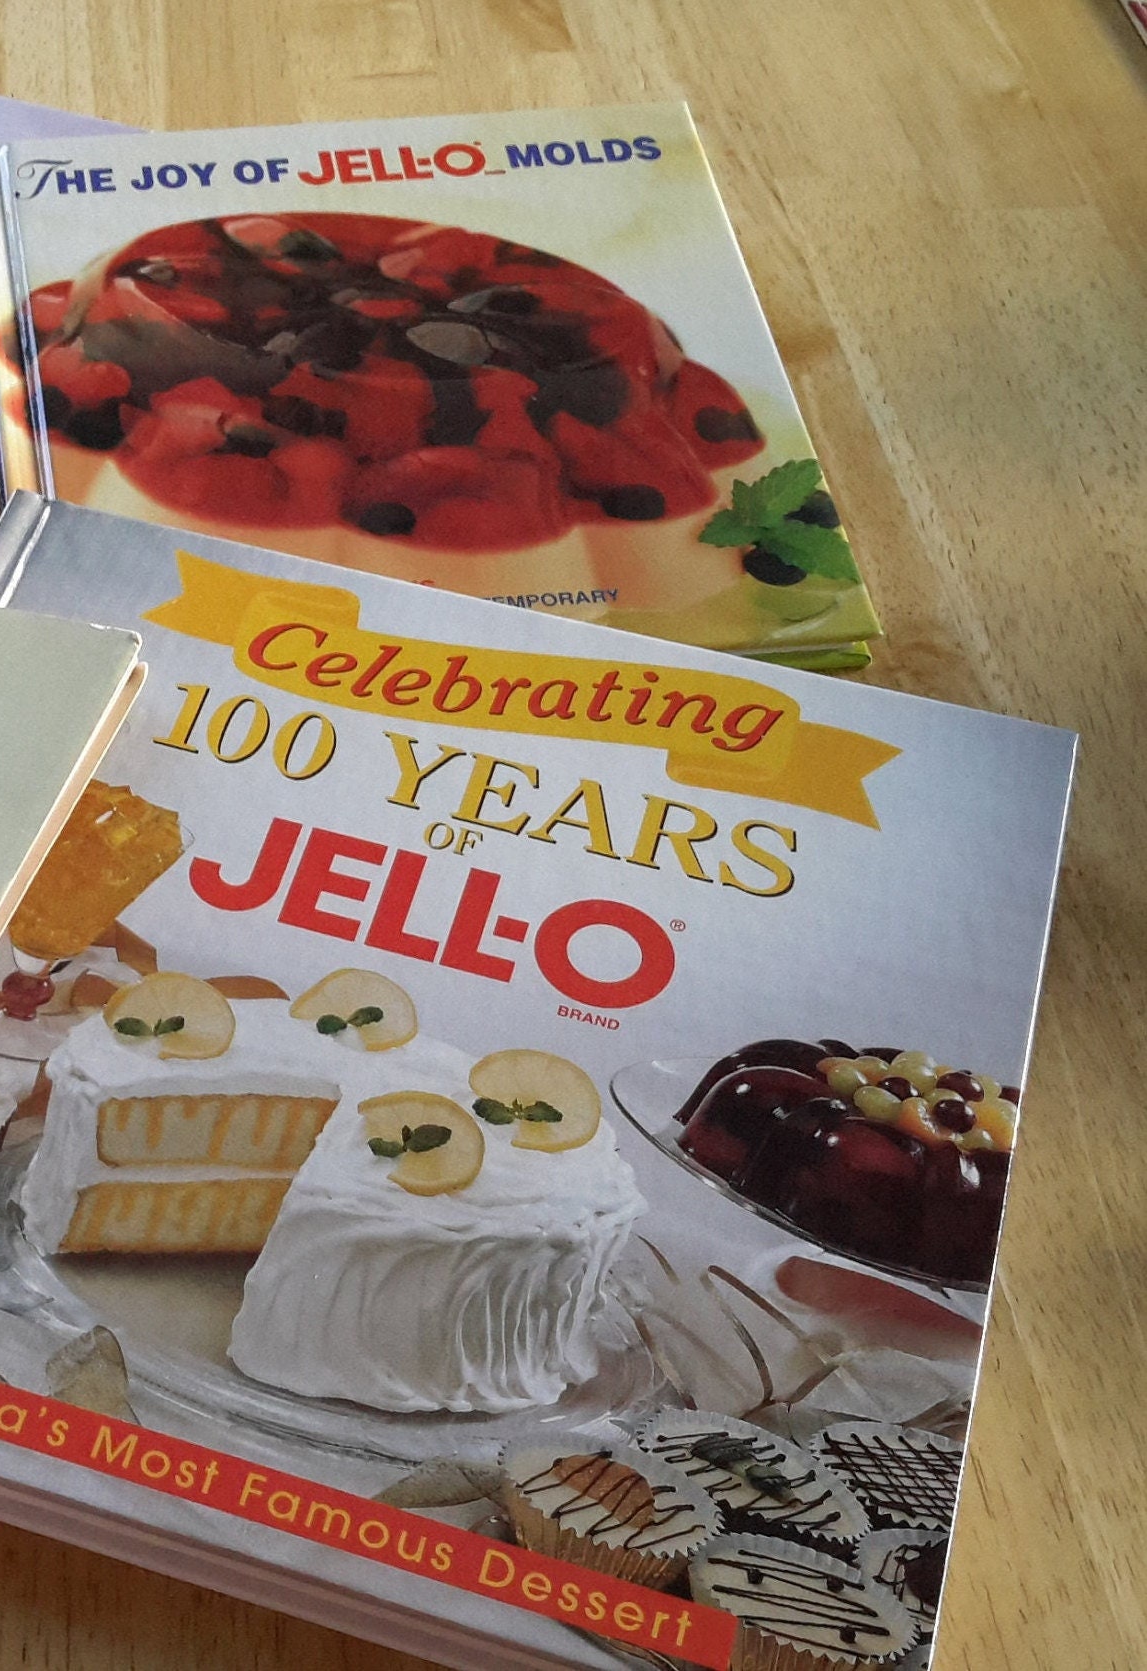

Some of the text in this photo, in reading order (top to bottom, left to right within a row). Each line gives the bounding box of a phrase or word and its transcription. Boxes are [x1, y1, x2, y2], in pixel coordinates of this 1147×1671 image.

[16, 136, 662, 199] THE JOY OF JELL-O MOLDS
[247, 622, 783, 751] Celebrating
[153, 683, 797, 898] 100 YEARS
[424, 822, 483, 856] OF
[189, 817, 675, 1010] JELL-O
[557, 1005, 620, 1031] BRAND
[92, 1425, 221, 1495] Most
[240, 1473, 454, 1574] Famous
[478, 1550, 693, 1648] Dessert
